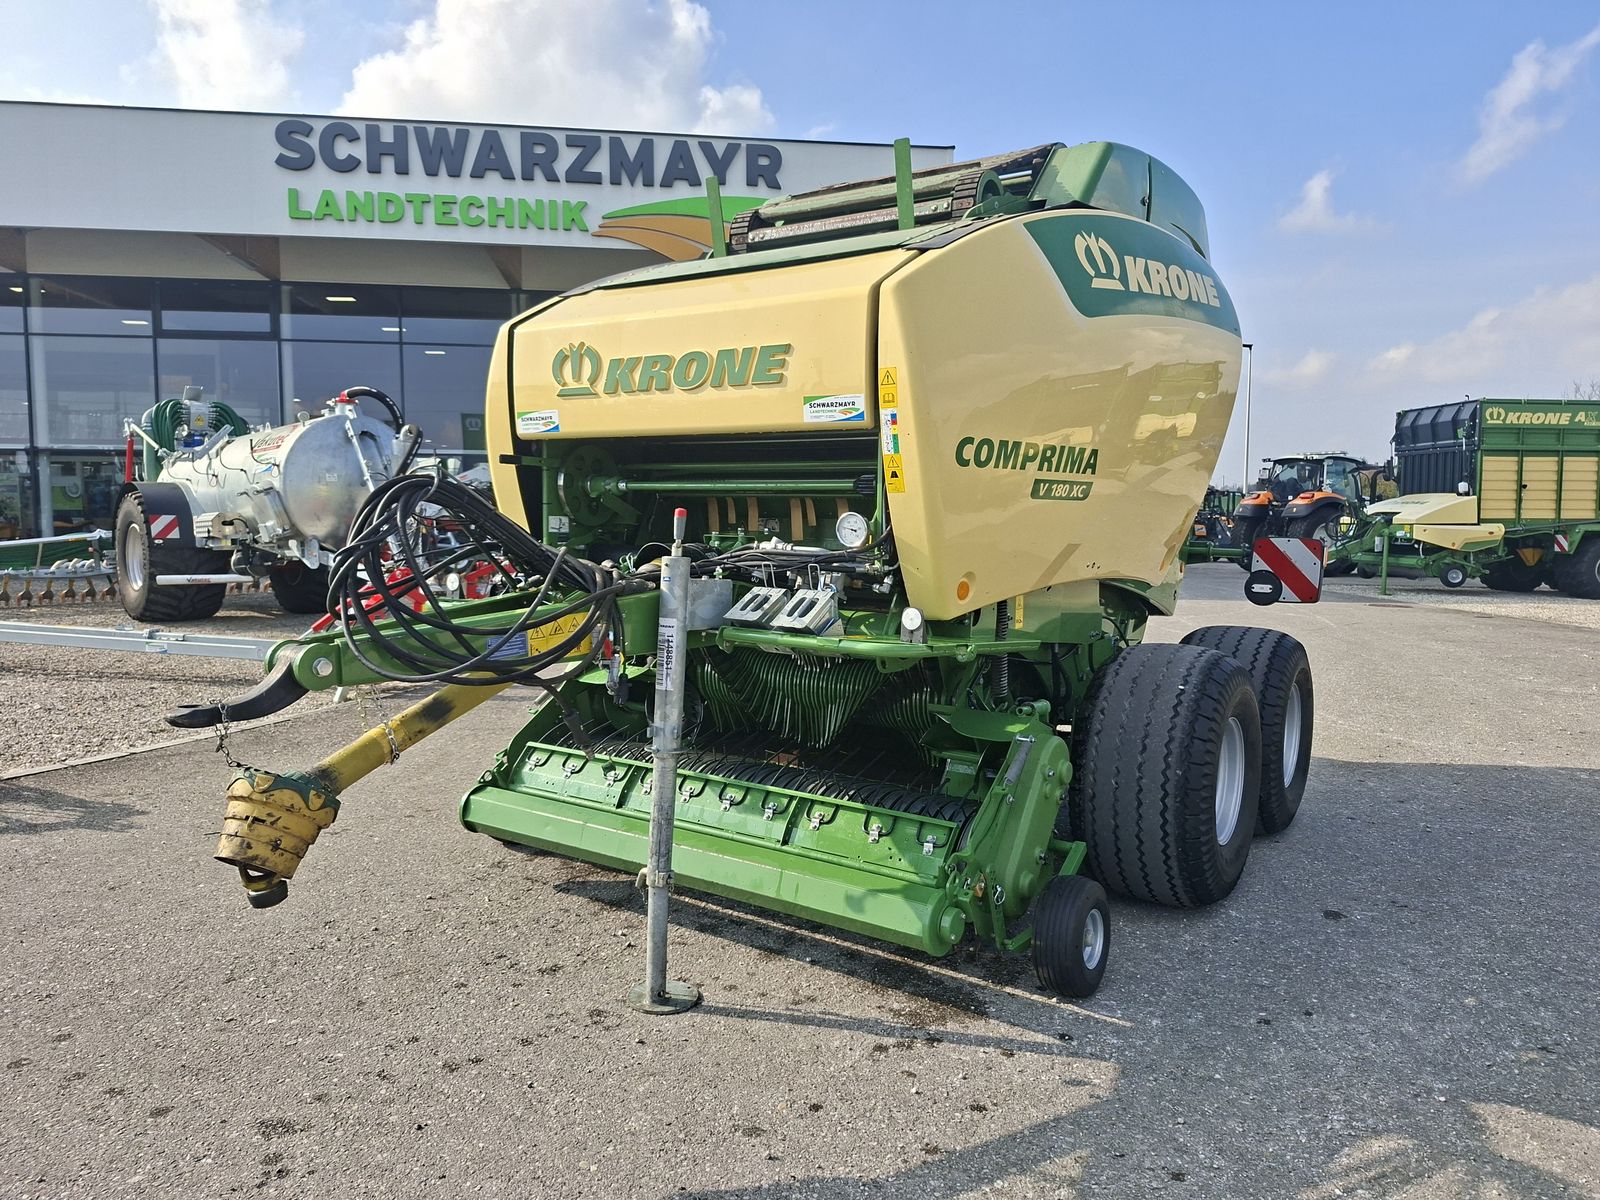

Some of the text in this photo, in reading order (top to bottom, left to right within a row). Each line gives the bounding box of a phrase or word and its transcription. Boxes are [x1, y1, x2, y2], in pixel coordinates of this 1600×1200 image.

[275, 119, 783, 189] SCHWARZMAYR
[287, 188, 589, 232] LANDTECHNIK
[1123, 255, 1221, 308] KRONE
[603, 343, 791, 395] KRONE
[1505, 412, 1572, 425] KRONE
[955, 436, 1099, 475] COMPRIMA
[1039, 483, 1087, 498] V 180 XC
